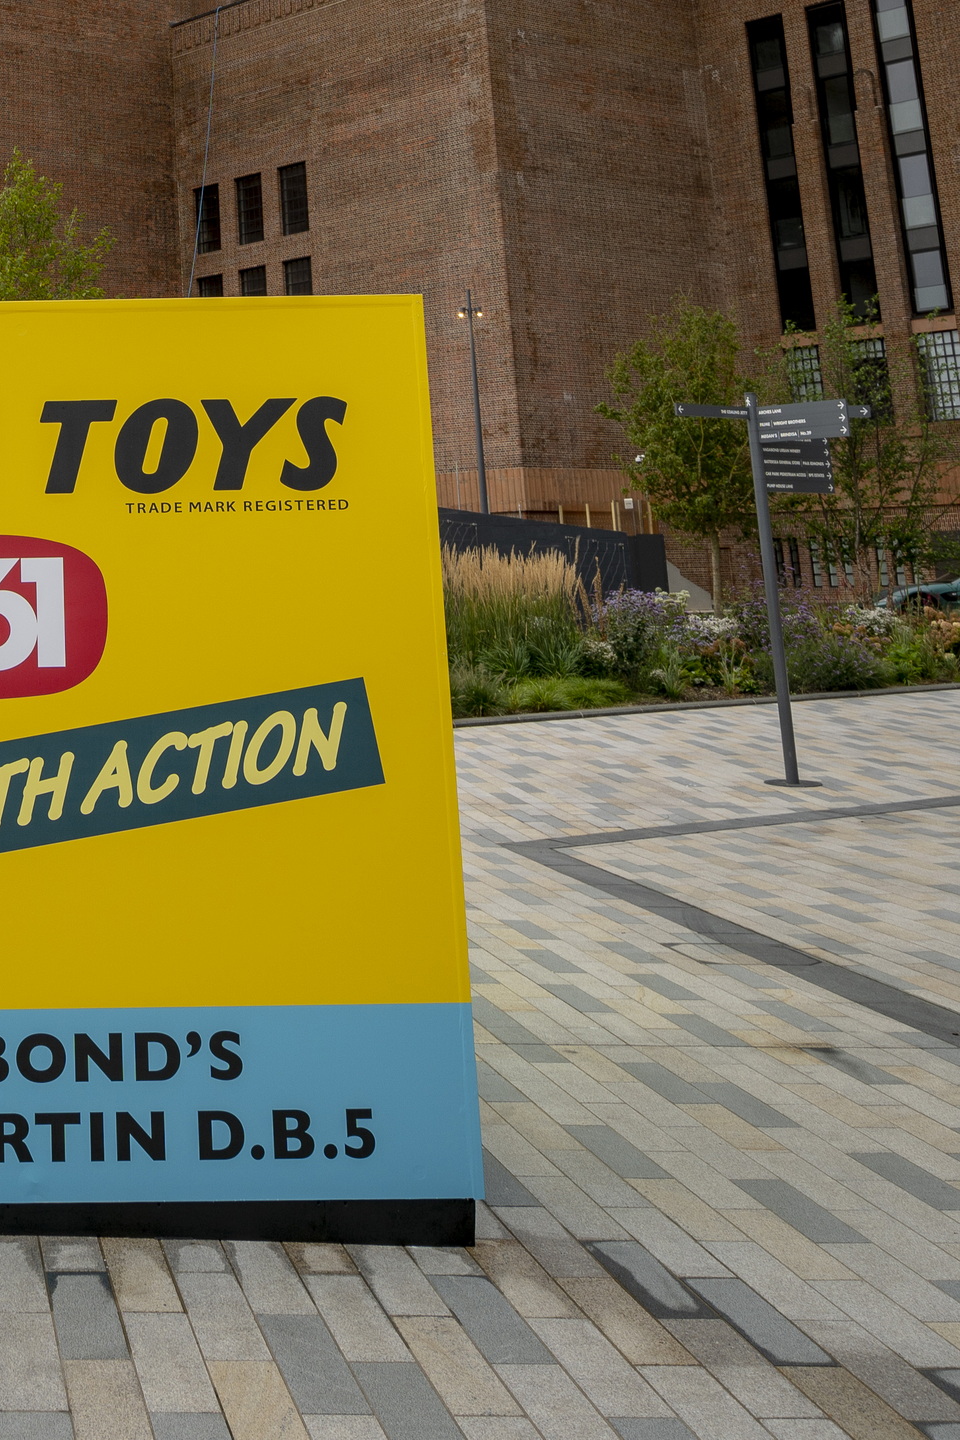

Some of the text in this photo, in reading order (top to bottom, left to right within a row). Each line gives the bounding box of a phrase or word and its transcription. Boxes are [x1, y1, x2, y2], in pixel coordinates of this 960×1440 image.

[39, 396, 349, 495] TOYS
[125, 499, 350, 514] TRADE MARK REGISTERED
[80, 701, 348, 816] ACTION
[197, 1108, 377, 1162] D.B.5
